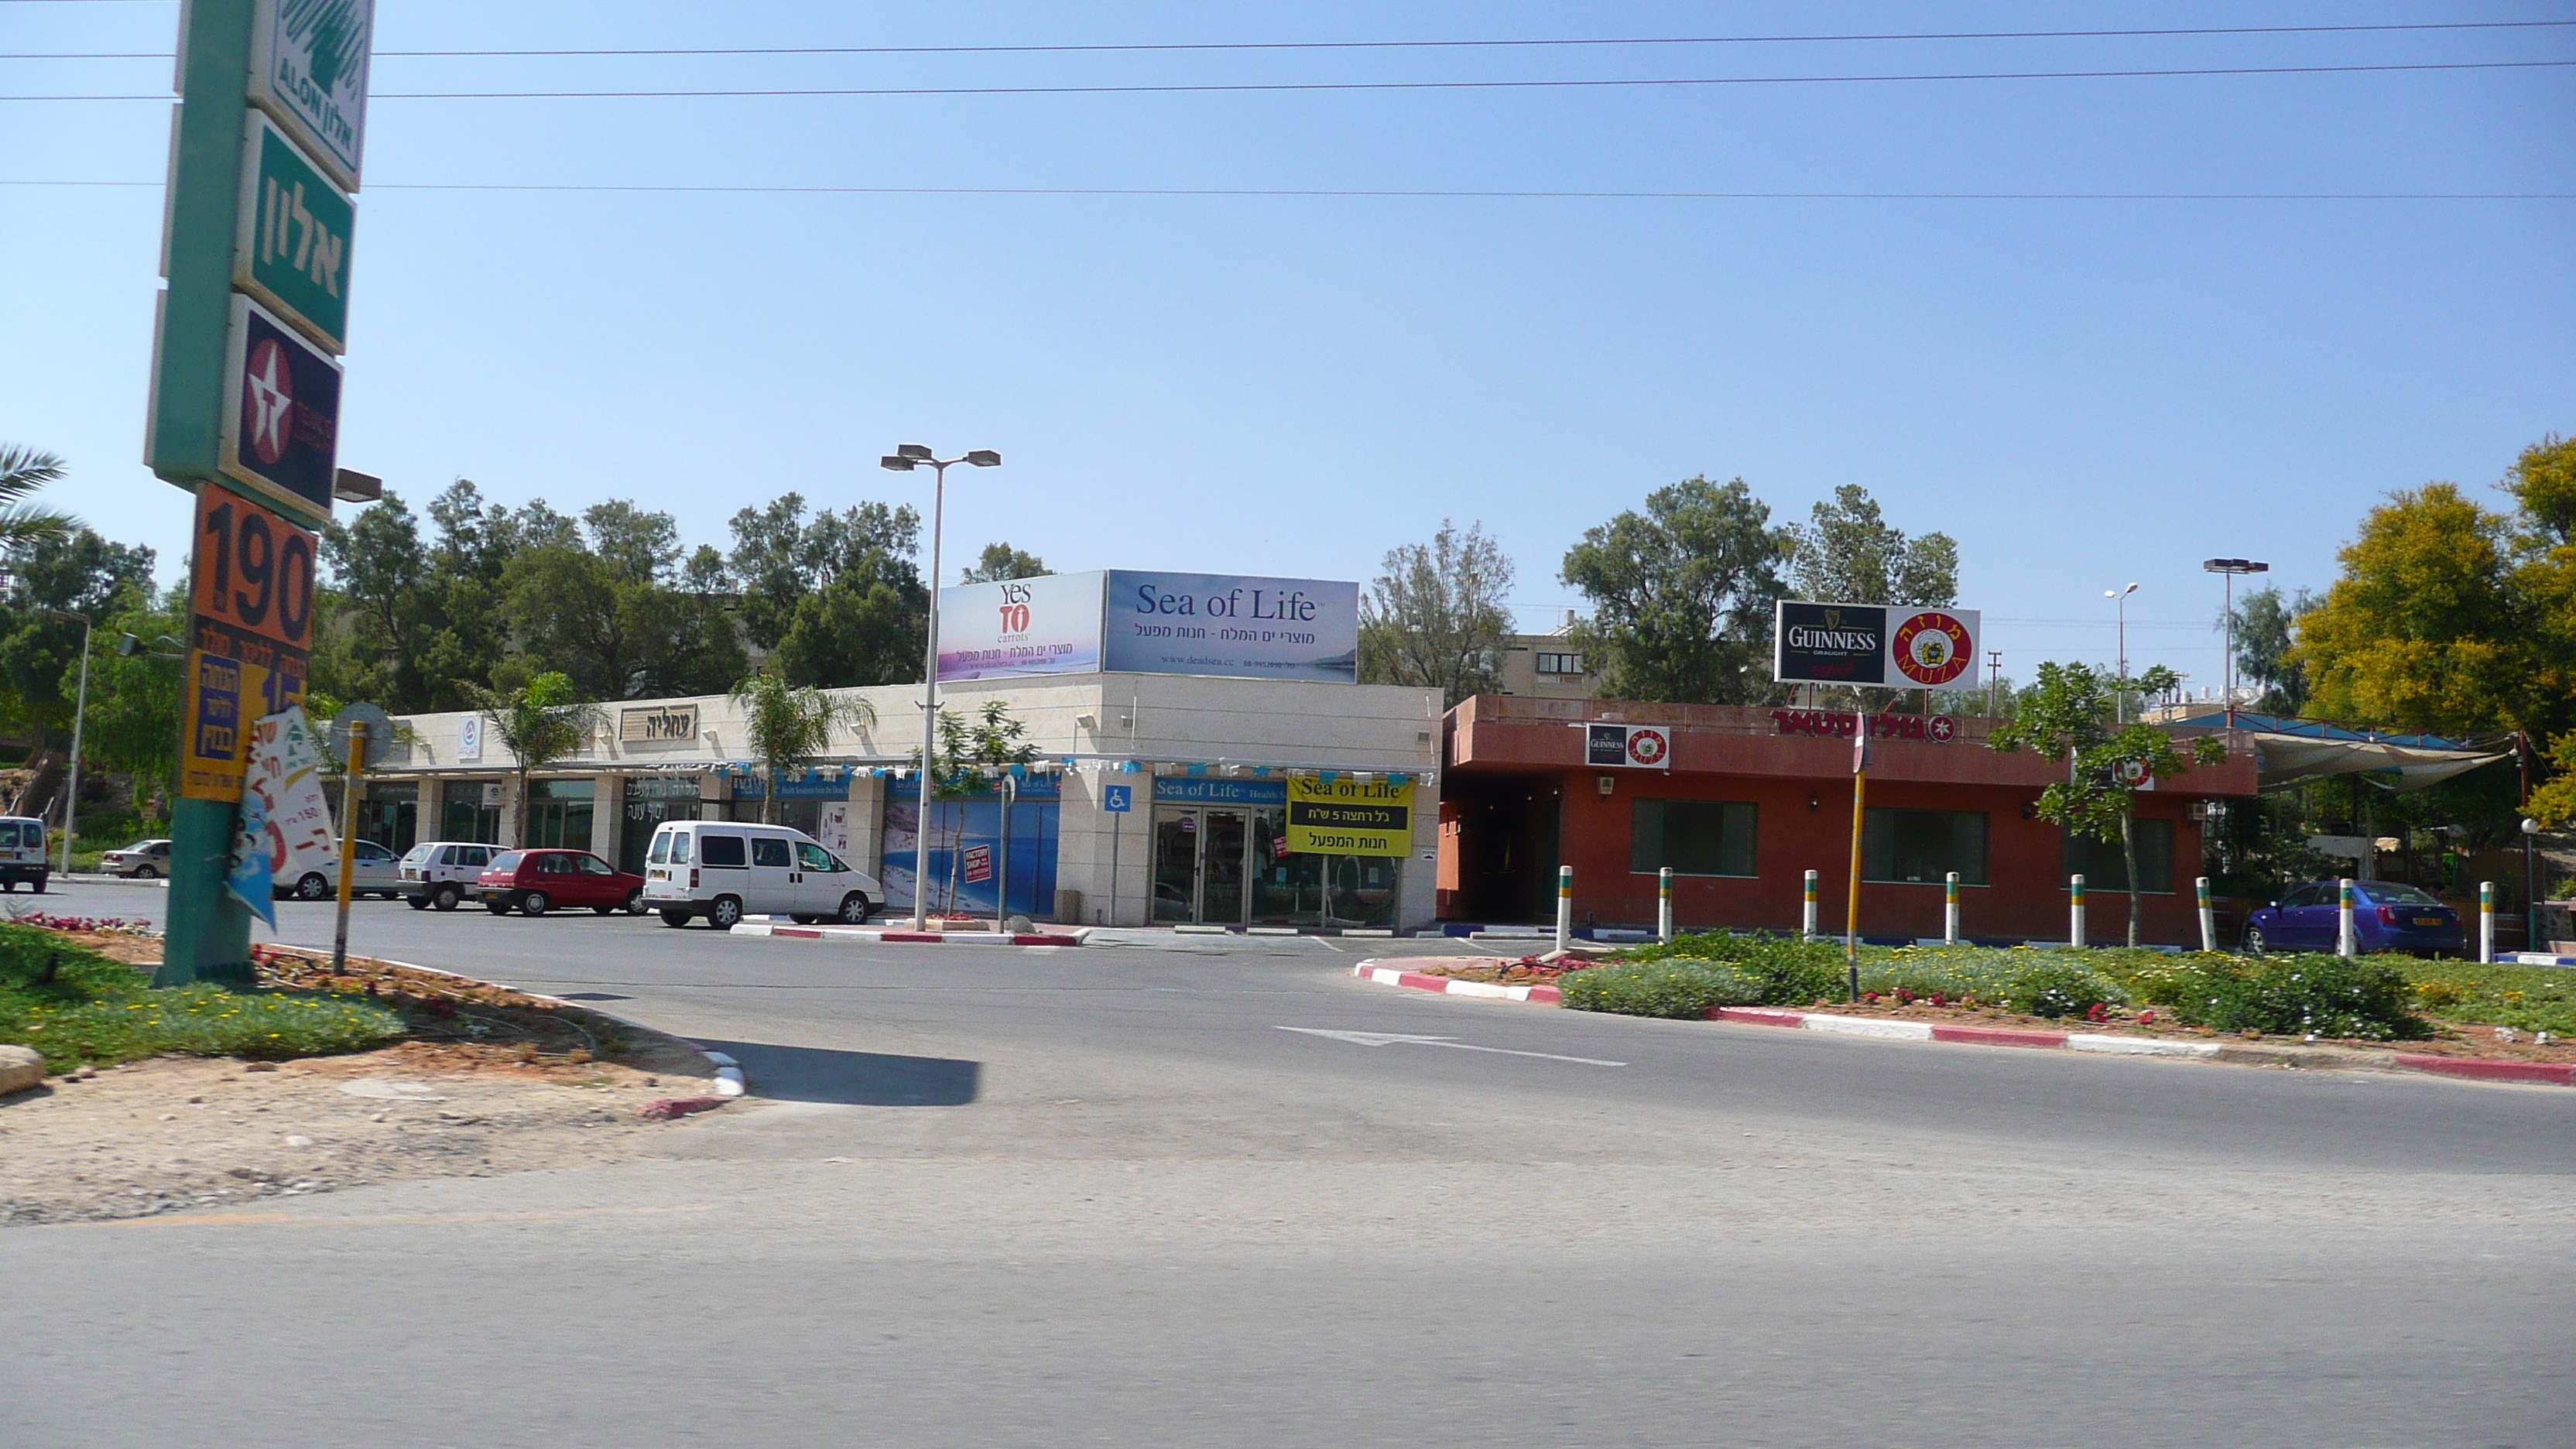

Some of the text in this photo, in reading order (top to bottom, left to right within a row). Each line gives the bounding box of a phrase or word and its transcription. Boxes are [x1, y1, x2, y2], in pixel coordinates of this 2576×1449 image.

[279, 57, 322, 120] ALON
[262, 176, 341, 299] אלון
[206, 502, 311, 643] 190
[1136, 584, 1195, 615] Sea
[1207, 588, 1242, 617] of
[1250, 590, 1316, 621] Life
[999, 605, 1030, 633] TO
[1135, 623, 1171, 637] מפעל
[1177, 627, 1205, 639] חנות
[1221, 628, 1257, 641] המלח
[1899, 615, 1961, 642] מוזה
[998, 633, 1029, 643] carrots
[1262, 633, 1275, 642] ים
[1279, 632, 1314, 644] מוצרי
[1789, 626, 1875, 650] GUINNESS
[982, 649, 1001, 659] חנות
[1010, 645, 1034, 657] המלח
[1036, 645, 1046, 656] ים
[1049, 642, 1073, 655] מוצרי
[957, 650, 979, 662] מפעל
[1898, 654, 1967, 683] MUZA
[647, 706, 690, 738] עתליה
[1591, 738, 1625, 749] GUINNESS
[1157, 781, 1183, 795] Sea
[1188, 783, 1204, 796] of
[1209, 783, 1240, 797] Life
[1249, 790, 1277, 799] Health
[1301, 778, 1333, 796] Sea
[1332, 810, 1339, 820] 5
[1342, 810, 1372, 821] רחצה
[1309, 831, 1387, 849] חנות המפעל
